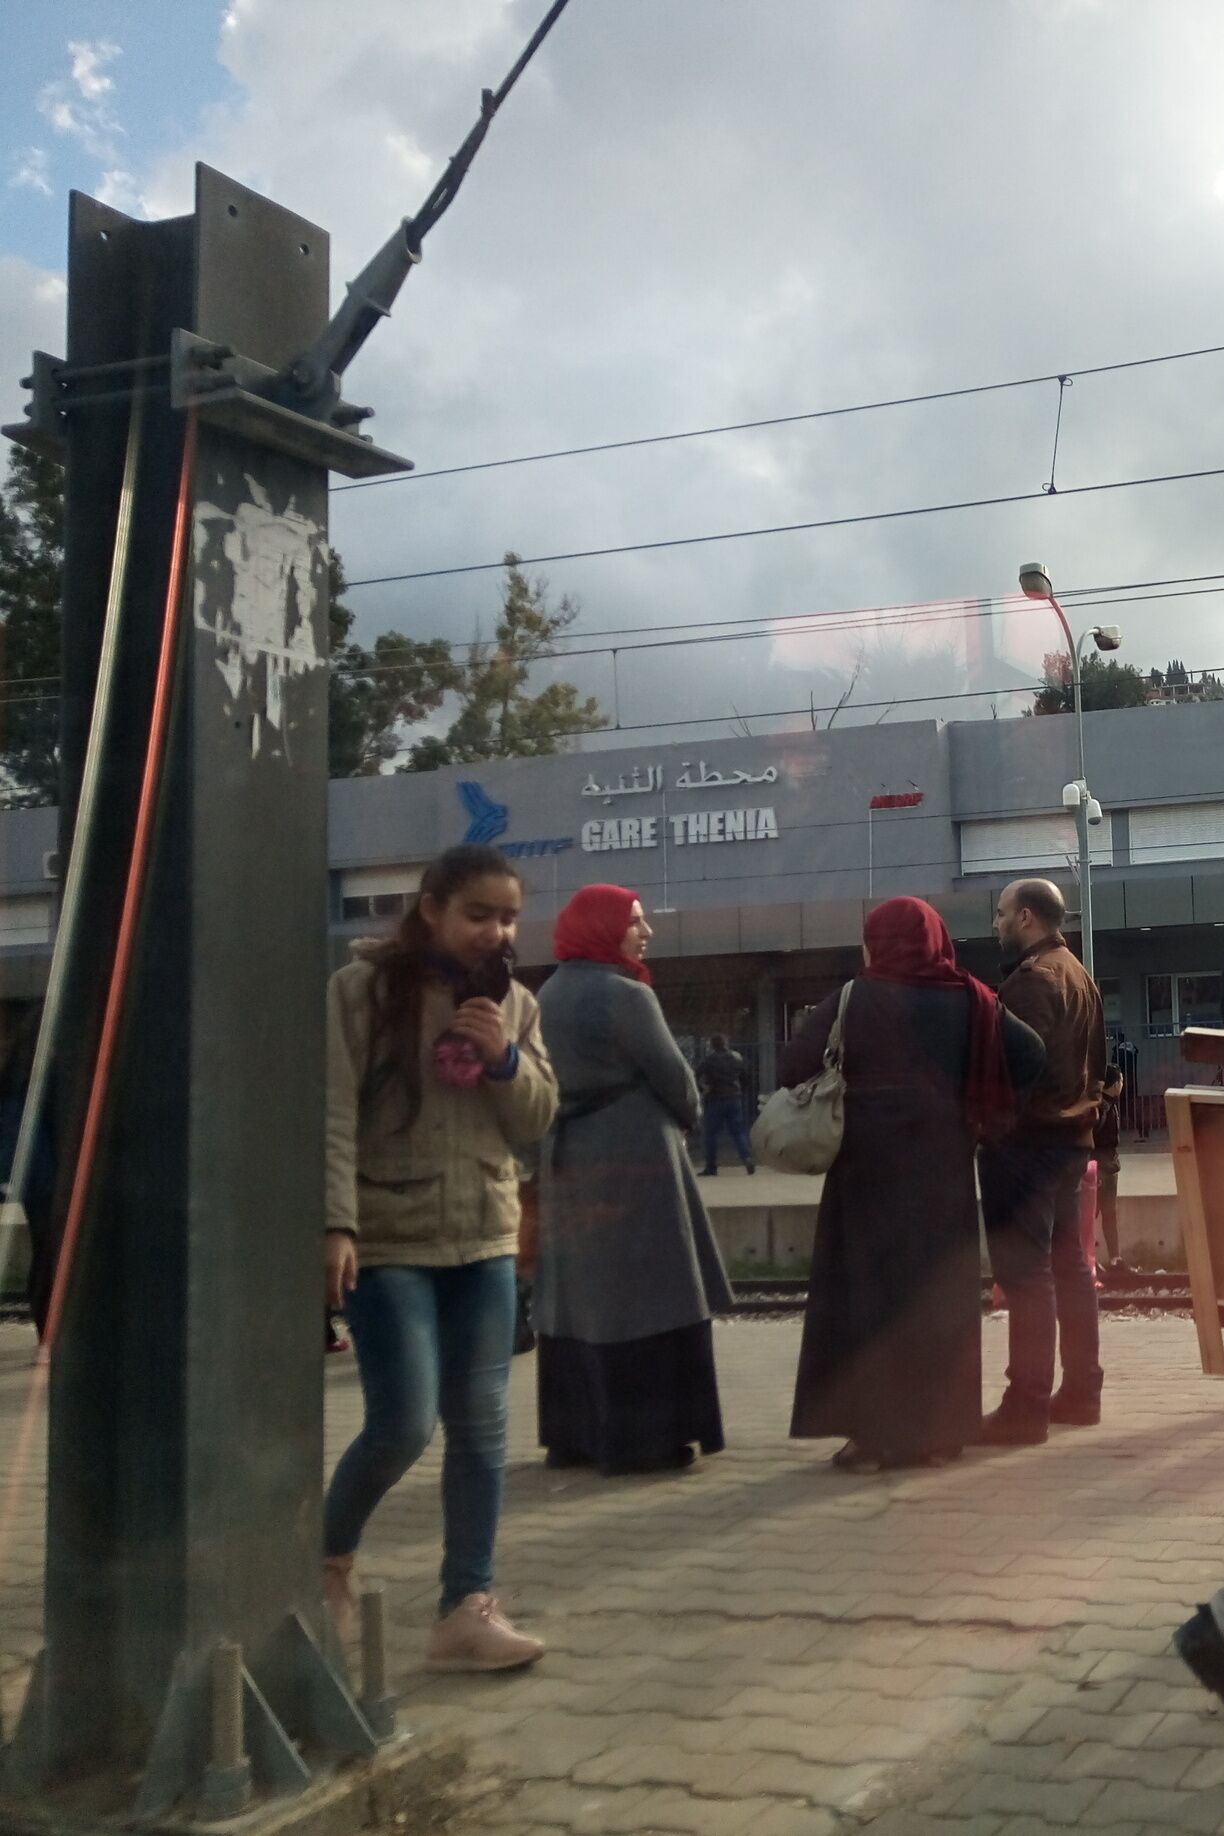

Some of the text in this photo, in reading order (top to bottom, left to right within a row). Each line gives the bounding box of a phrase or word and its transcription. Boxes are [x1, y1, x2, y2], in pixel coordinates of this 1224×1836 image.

[676, 760, 778, 788] محطة
[581, 816, 658, 852] GARE
[669, 807, 779, 846] THENIA
